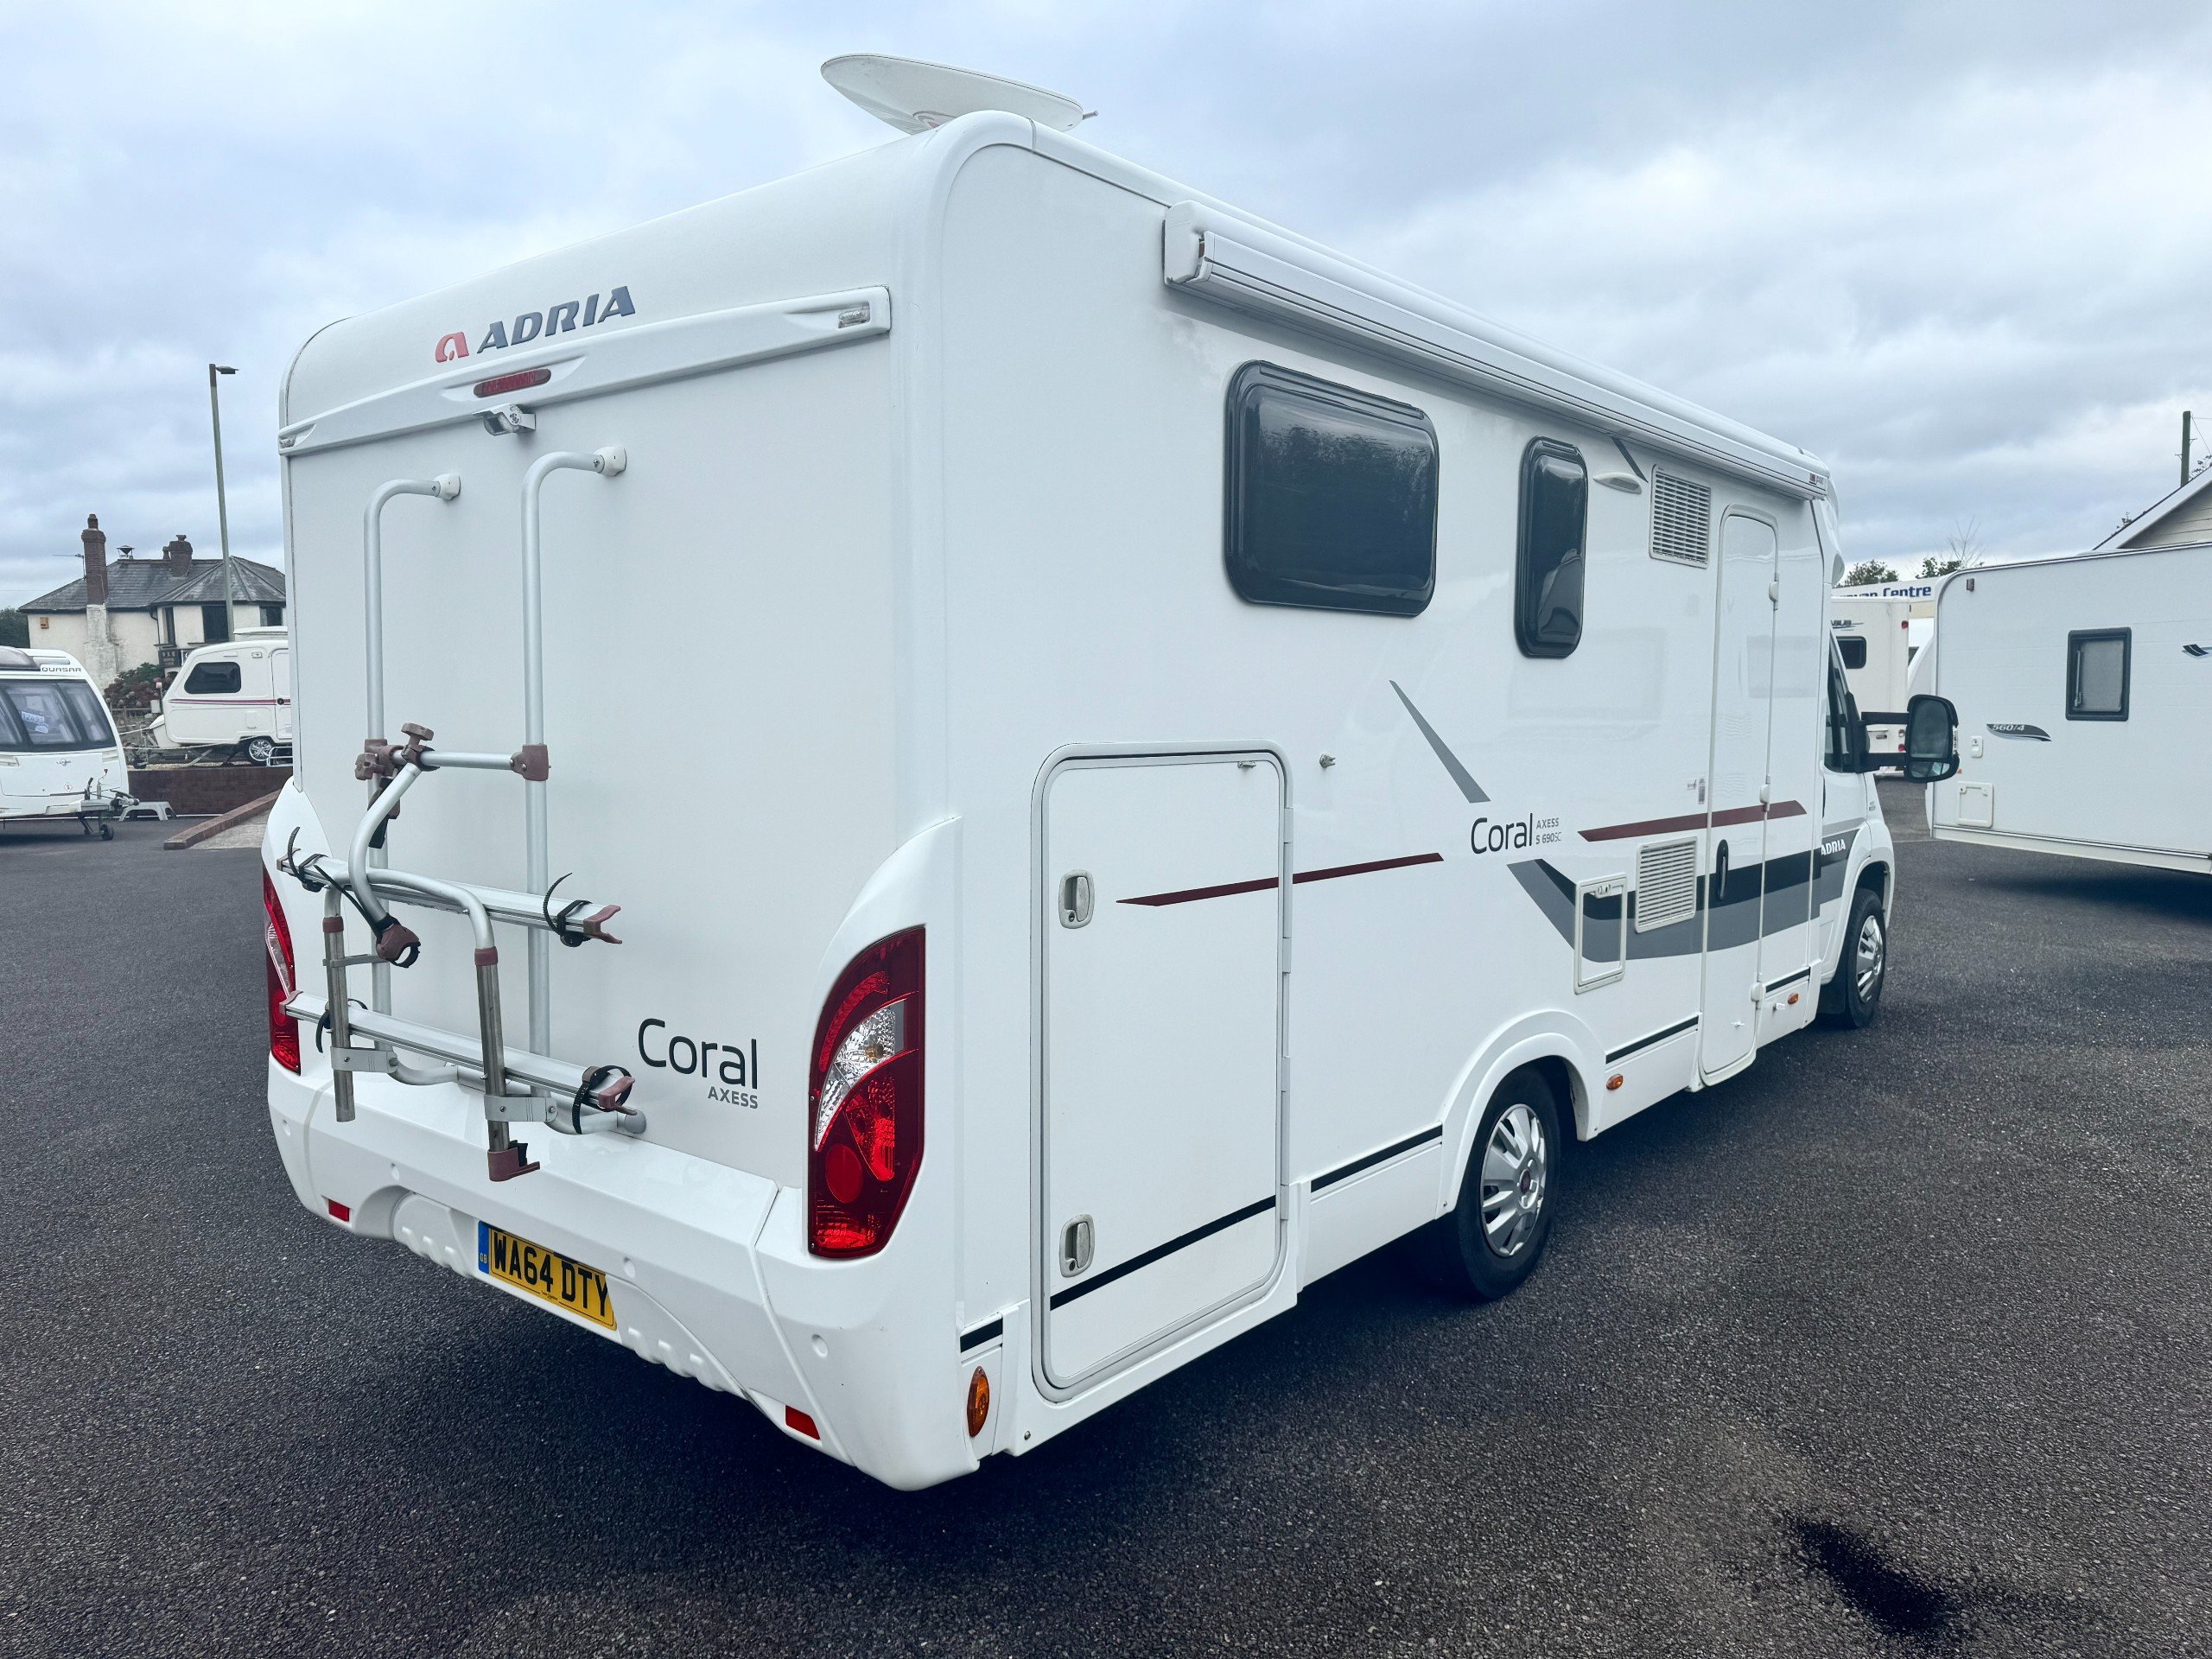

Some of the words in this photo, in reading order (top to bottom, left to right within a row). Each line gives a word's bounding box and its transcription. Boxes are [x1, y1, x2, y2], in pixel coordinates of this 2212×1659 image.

[476, 285, 636, 354] ADRIA
[1883, 586, 1932, 598] Centre
[1471, 812, 1533, 855] Coral
[1535, 817, 1560, 830] AXESS
[1821, 838, 1847, 855] ADRIA
[638, 1017, 758, 1090] Coral
[707, 1085, 759, 1109] AXESS
[480, 1252, 487, 1264] GB
[493, 1231, 554, 1293] WA64
[561, 1259, 608, 1317] DTY
